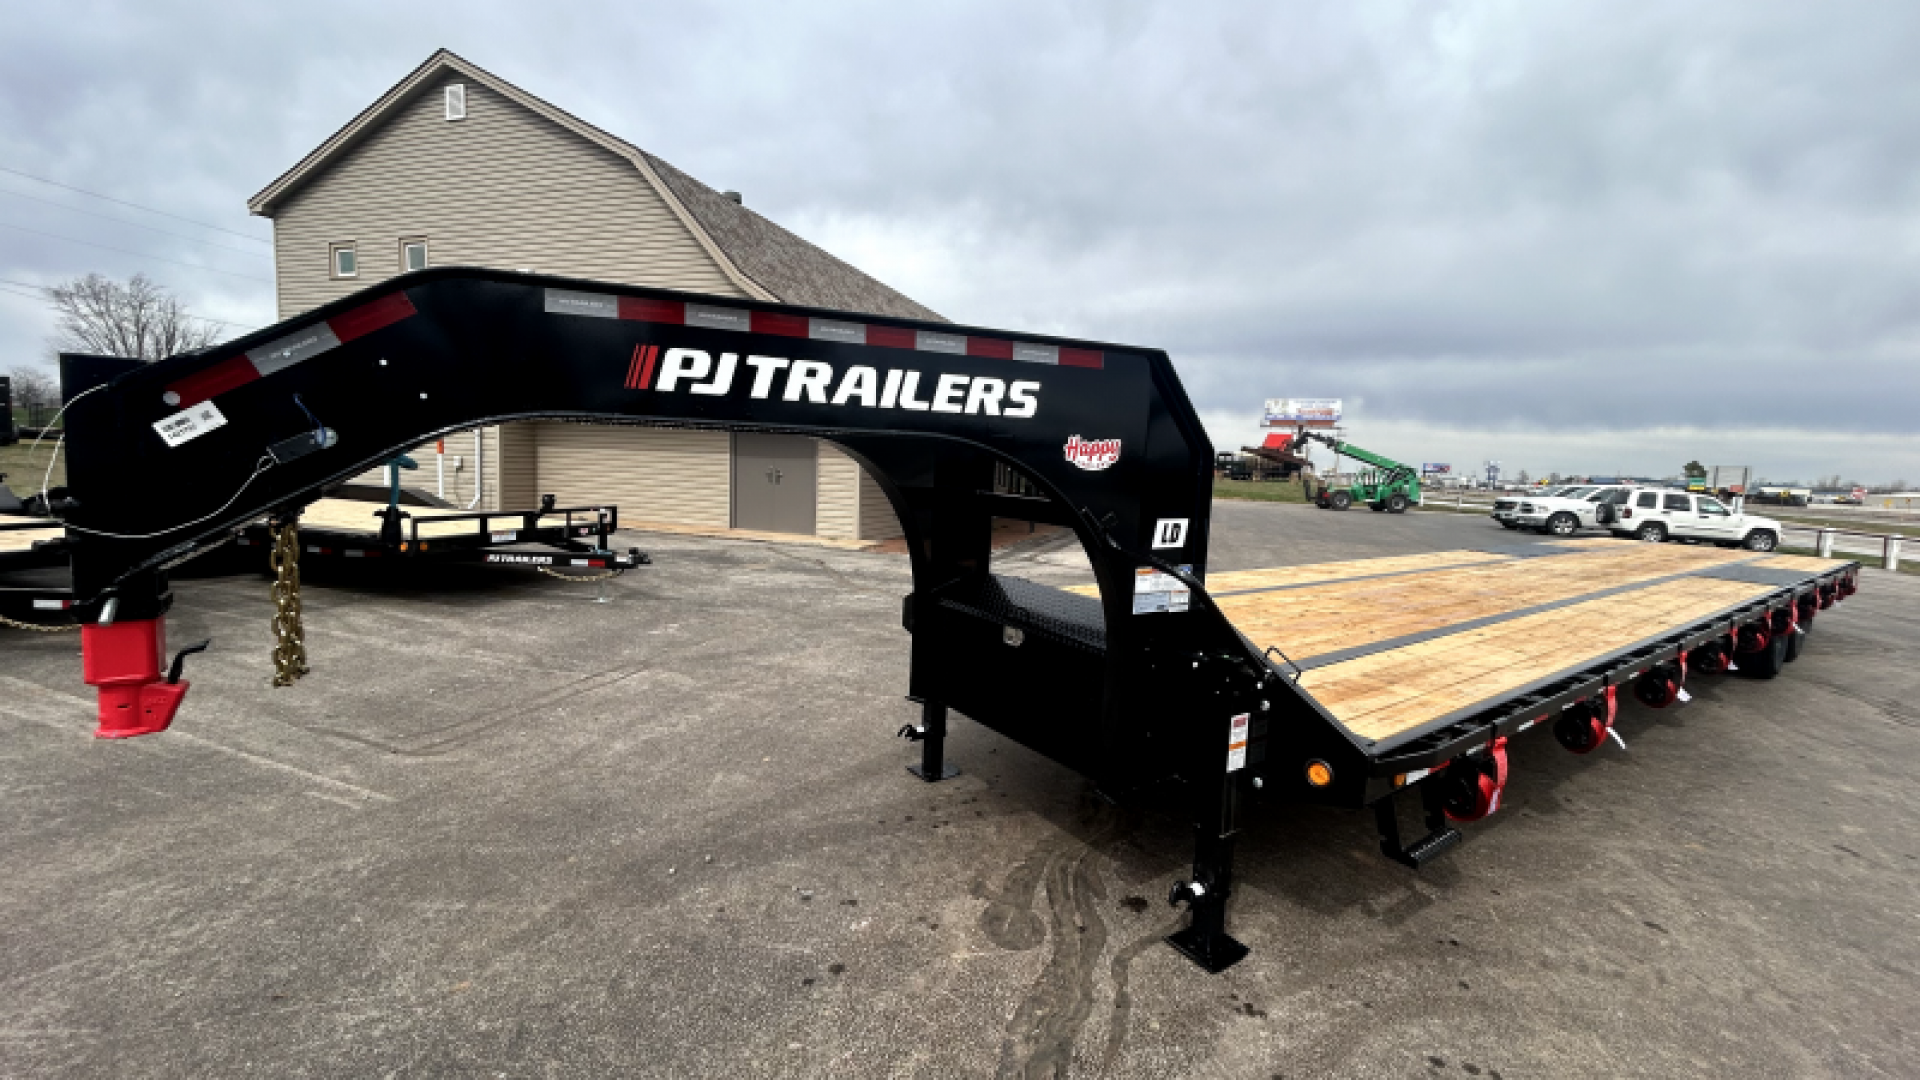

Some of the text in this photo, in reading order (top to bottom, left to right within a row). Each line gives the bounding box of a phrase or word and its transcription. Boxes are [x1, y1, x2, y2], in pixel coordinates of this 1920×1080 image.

[655, 346, 1042, 419] PJ TRAILERS
[1065, 437, 1120, 462] Happy
[1161, 522, 1182, 543] LD
